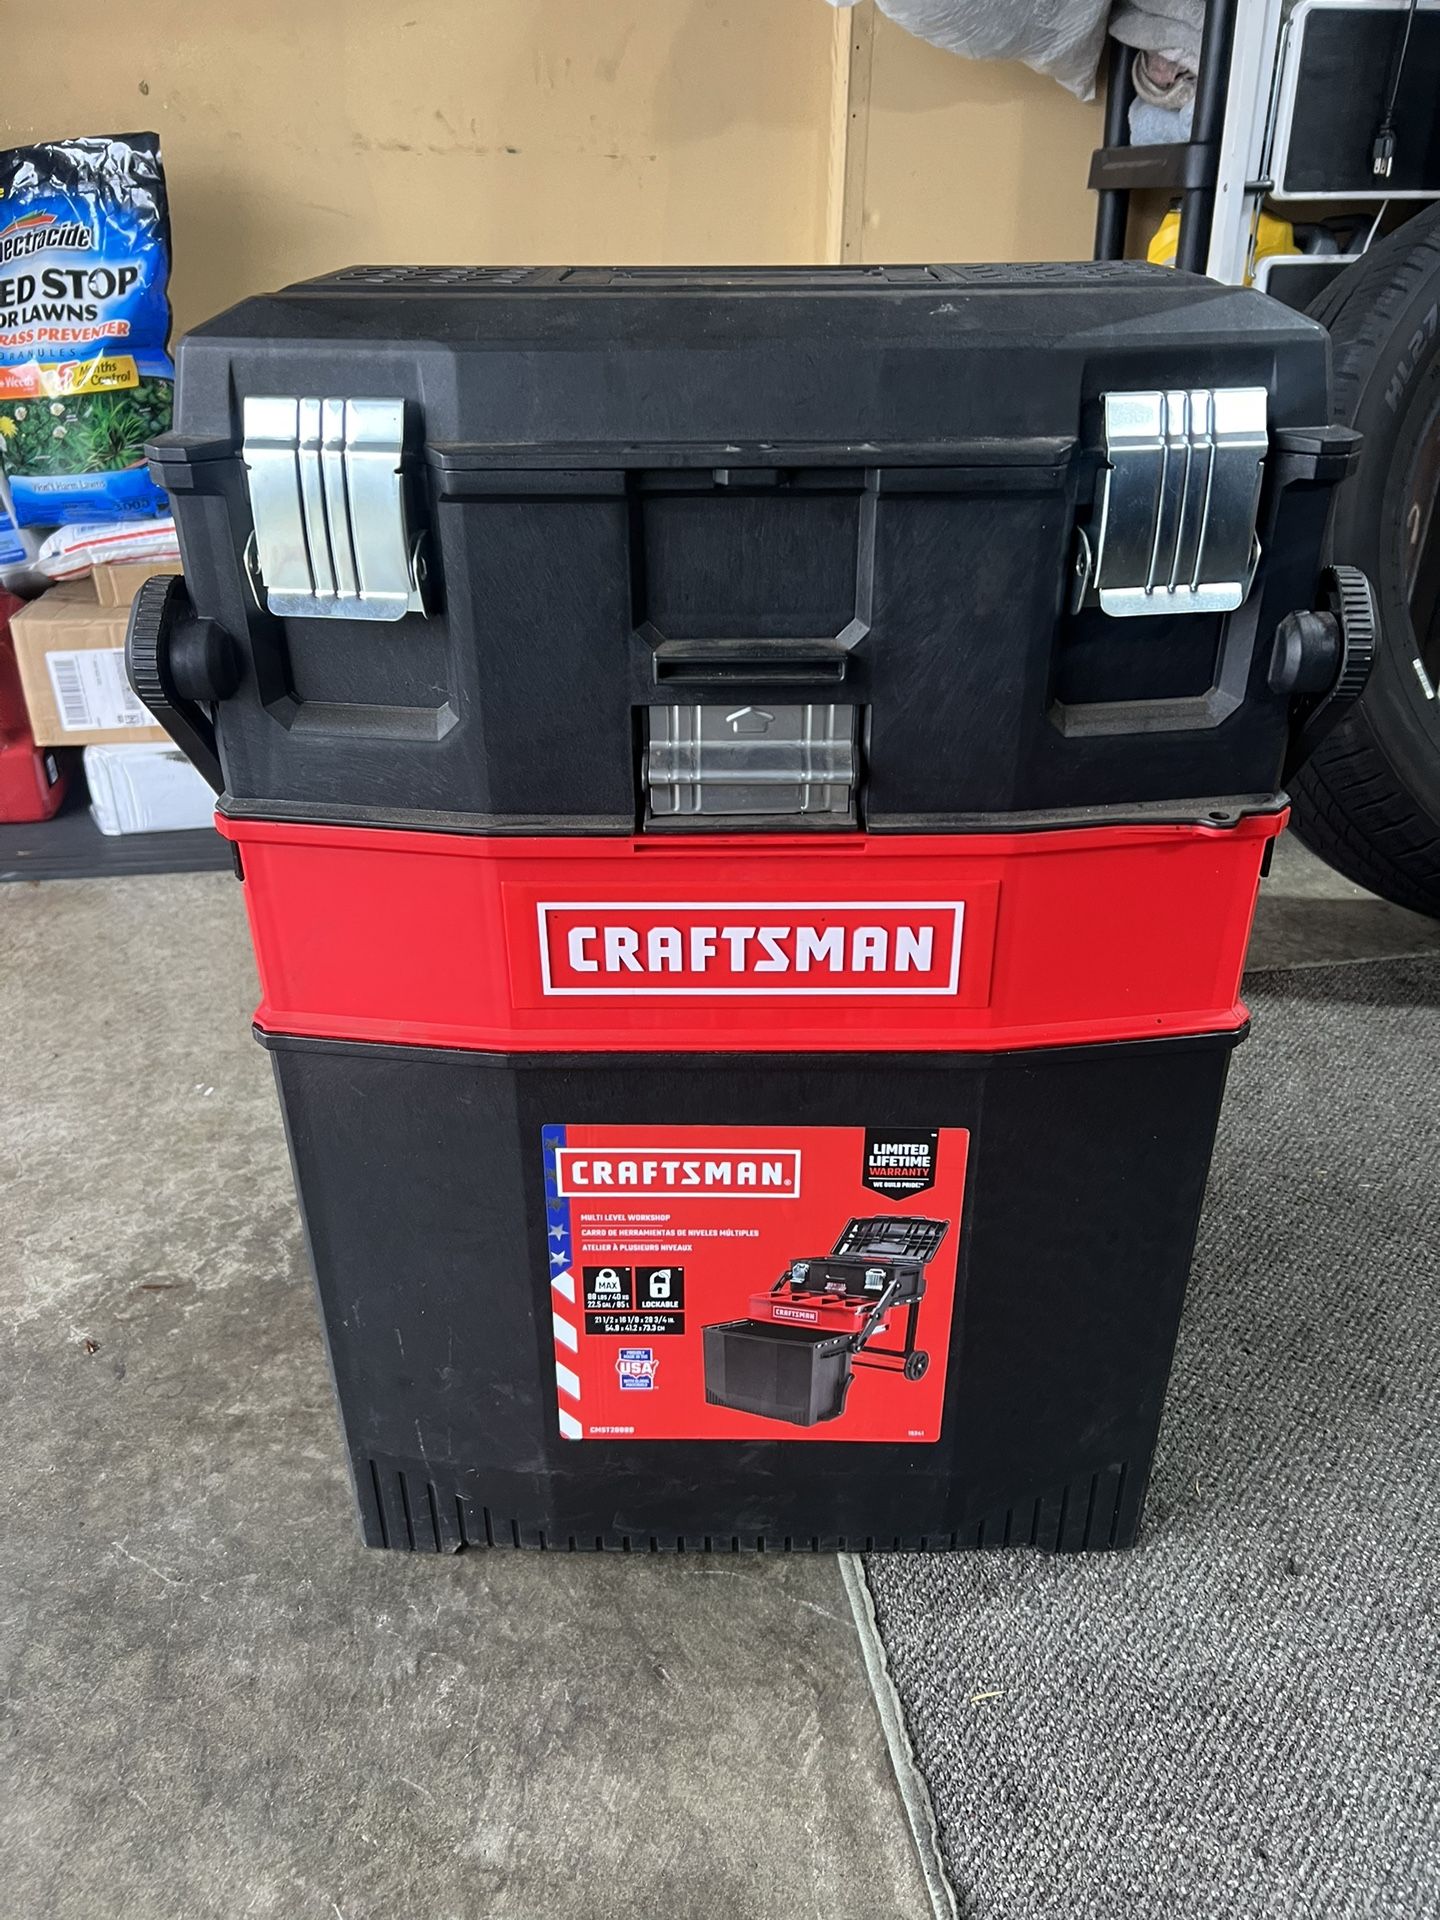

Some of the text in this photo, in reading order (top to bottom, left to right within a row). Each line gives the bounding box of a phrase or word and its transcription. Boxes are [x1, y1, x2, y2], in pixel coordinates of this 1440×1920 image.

[42, 267, 138, 299] STOP
[22, 304, 98, 324] LAWNS
[37, 322, 129, 341] PREVENTER
[567, 926, 934, 972] CRAFTSMAN
[873, 1143, 929, 1155] LIMITED
[868, 1155, 931, 1167] LIFETIME
[869, 1167, 930, 1176] WARRANTY
[627, 1214, 671, 1222] WORKSHOP
[581, 1229, 607, 1237] CARRO
[608, 1229, 617, 1237] DE
[618, 1229, 675, 1237] HERRAMIENTAS
[676, 1229, 687, 1237] DE
[688, 1229, 718, 1237] NIVELES
[582, 1243, 612, 1251] ATELIER
[620, 1243, 659, 1251] PLUSIEURS
[654, 1316, 667, 1324] 3/4
[775, 1308, 815, 1320] CRAFTSMAN
[620, 1362, 653, 1374] USA
